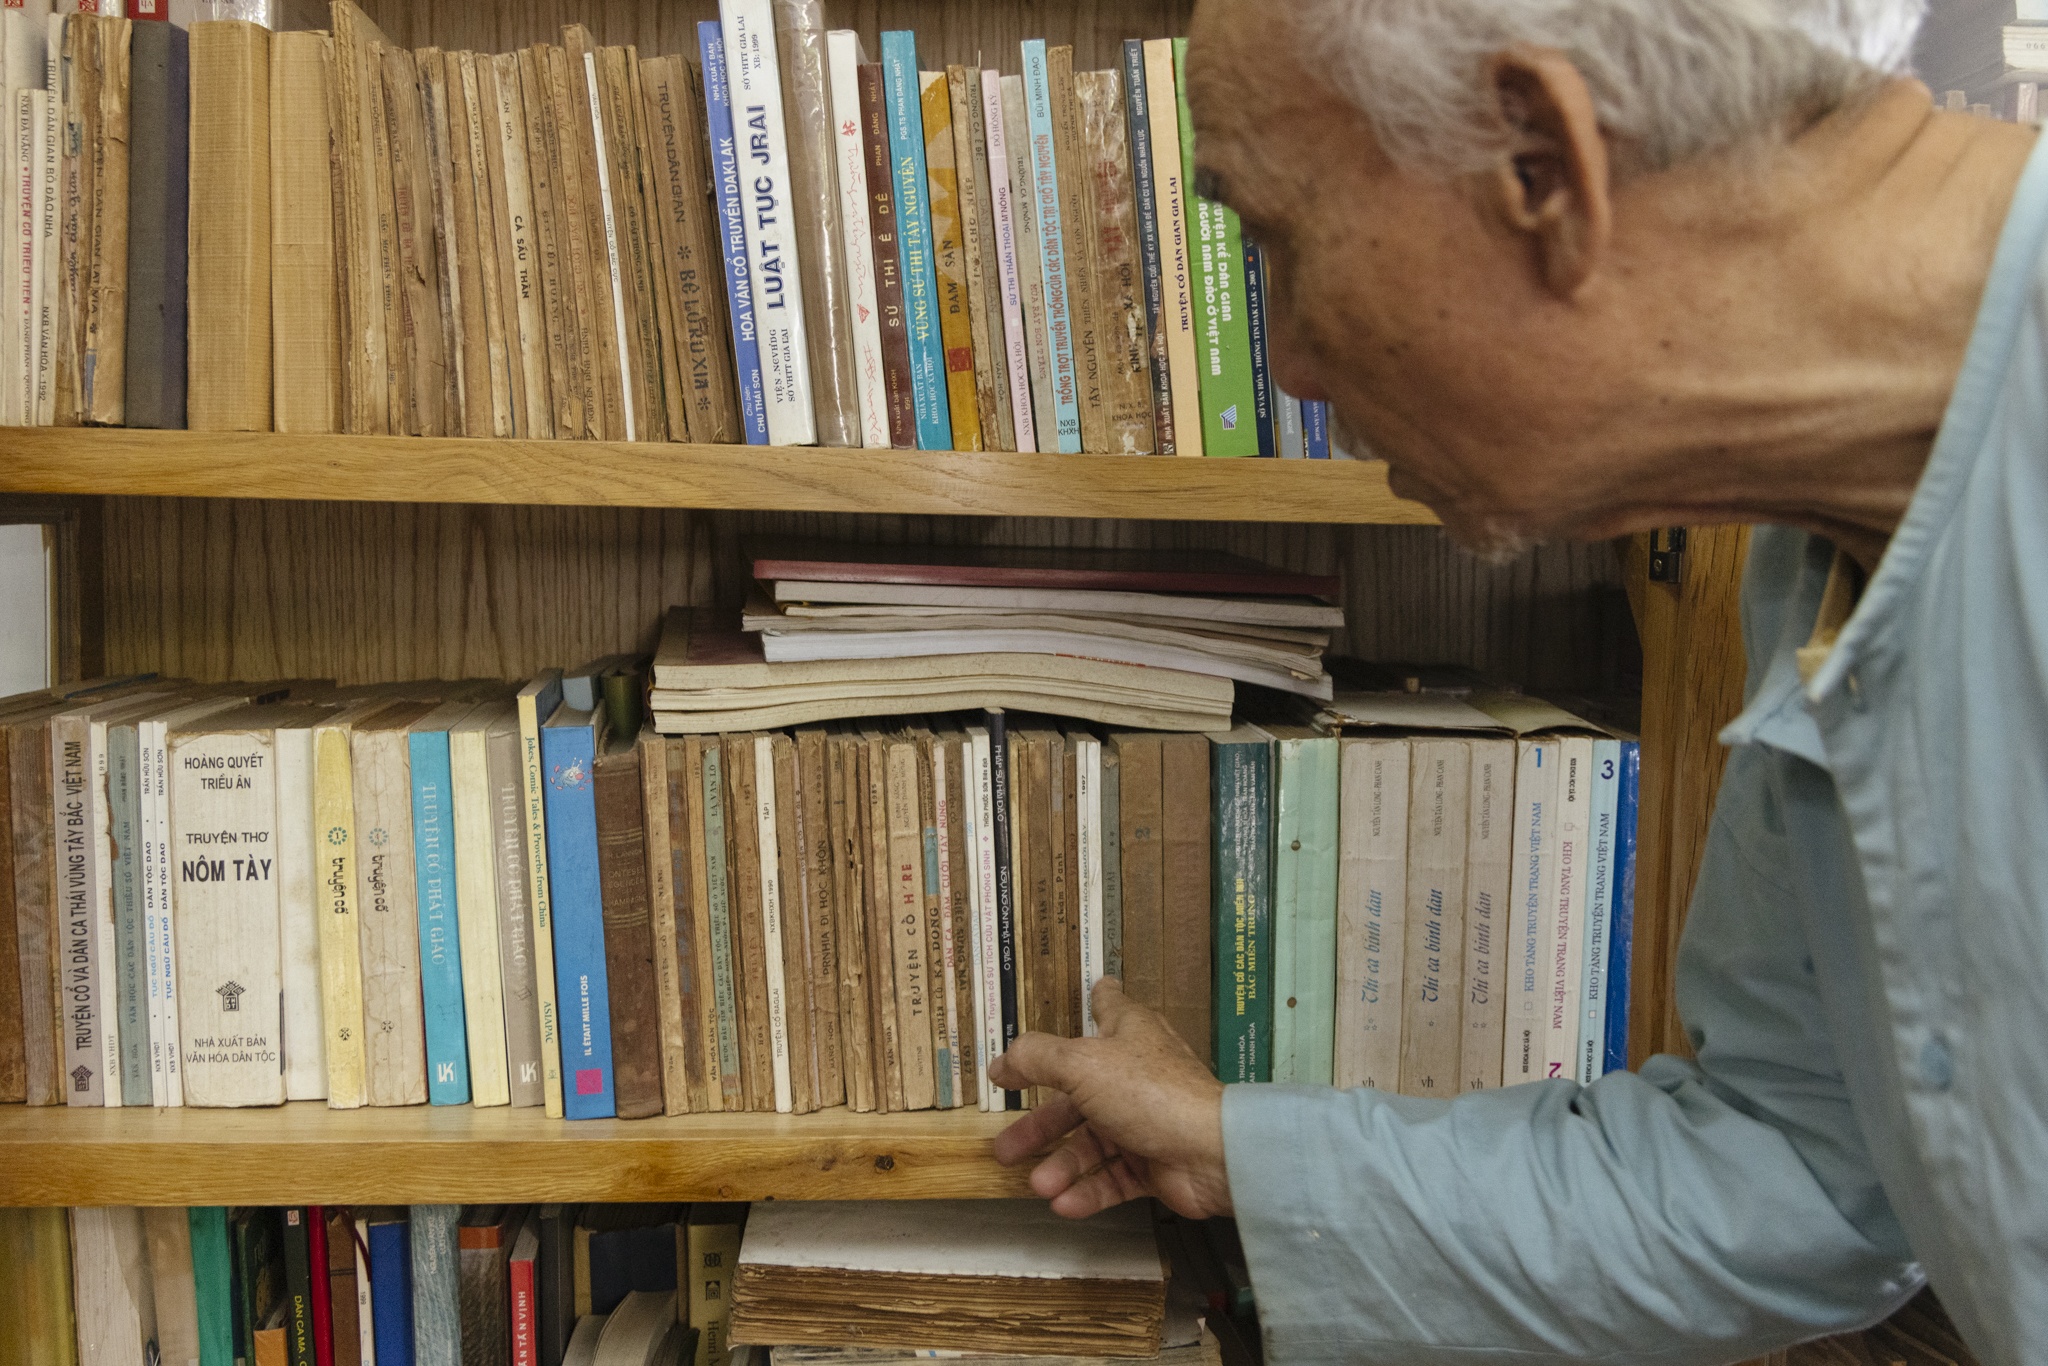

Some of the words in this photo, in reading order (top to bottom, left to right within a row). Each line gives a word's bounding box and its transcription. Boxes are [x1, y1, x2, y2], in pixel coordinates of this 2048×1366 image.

[737, 16, 746, 31] LAI
[706, 43, 716, 60] BẢN
[739, 33, 747, 49] GIA
[751, 34, 759, 52] 1999
[708, 62, 718, 82] XUẤT
[740, 52, 750, 77] VHTT
[753, 55, 761, 69] XB:
[1031, 57, 1042, 76] ĐẠO
[711, 84, 720, 101] NHÀ
[742, 78, 751, 90] SỞ
[869, 81, 878, 102] NHẬT
[1034, 78, 1044, 101] MINH
[47, 108, 57, 132] DÂN
[657, 81, 675, 146] TRUYỆN
[1036, 103, 1045, 118] BÙI
[746, 104, 771, 165] JRAI
[872, 113, 880, 134] ĐĂNG
[47, 135, 55, 163] GIAN
[874, 144, 882, 166] PHAN
[666, 149, 679, 182] DÂN
[719, 137, 738, 194] DAKLAK
[897, 156, 918, 215] NGUYÊN
[1169, 177, 1177, 195] LAI
[671, 184, 685, 223] GIAN
[753, 175, 779, 229] TỤC
[998, 187, 1009, 222] M'NÔNG
[1170, 198, 1179, 217] GIA
[44, 215, 53, 238] NHA
[722, 197, 744, 253] TRUYỀN
[903, 219, 921, 246] TÂY
[1002, 223, 1012, 250] THOẠI
[1172, 219, 1182, 245] GIAN
[878, 233, 891, 242] Ê
[726, 256, 747, 277] CỔ
[909, 249, 922, 274] THI
[1175, 249, 1184, 271] DÂN
[758, 240, 786, 310] LUẬT
[883, 259, 896, 287] THI
[1174, 273, 1186, 288] CỔ
[735, 280, 751, 308] VĂN
[907, 275, 926, 297] SỬ
[1008, 293, 1017, 306] SỬ
[1179, 291, 1189, 332] TRUYỆN
[740, 311, 755, 341] HOA
[884, 306, 900, 327] SỬ
[911, 299, 930, 341] VÙNG
[751, 369, 761, 388] SƠN
[753, 391, 764, 411] THÁI
[756, 412, 766, 433] CHU
[64, 741, 81, 767] NAM
[184, 753, 225, 770] HOÀNG
[227, 751, 264, 770] QUYẾT
[525, 736, 536, 763] Jokes,
[1535, 748, 1542, 768] 1
[528, 764, 539, 794] Comic
[1600, 759, 1614, 780] 3
[62, 770, 86, 796] VIỆT
[201, 773, 234, 791] TRIỀU
[236, 774, 252, 790] ÂN
[59, 801, 83, 826] BẮC
[531, 796, 540, 821] Tales
[1532, 802, 1542, 827] NAM
[533, 823, 540, 831] &
[1135, 827, 1151, 839] 2
[1600, 813, 1610, 837] NAM
[63, 829, 84, 852] TÂY
[186, 830, 239, 847] TRUYỆN
[243, 831, 270, 844] THƠ
[1527, 828, 1541, 853] VIỆT
[1596, 838, 1609, 863] VIỆT
[532, 833, 543, 874] Proverbs
[982, 850, 991, 870] SINH
[1562, 841, 1573, 865] KHO
[64, 855, 85, 888] VÙNG
[182, 855, 225, 883] NÔM
[233, 854, 272, 882] TÀY
[999, 866, 1008, 887] NGỤ
[1529, 855, 1540, 891] TRẠNG
[535, 876, 545, 898] from
[981, 872, 992, 904] PHÓNG
[1561, 867, 1574, 895] TÀNG
[1595, 865, 1608, 901] TRẠNG
[65, 890, 87, 917] THÁI
[1001, 888, 1010, 919] NGÔN
[1425, 888, 1443, 916] dân
[1523, 893, 1539, 935] TRUYỆN
[538, 901, 547, 928] China
[901, 914, 916, 936] CỔ
[982, 906, 994, 923] VẬT
[1247, 894, 1256, 940] TRUNG
[1558, 897, 1570, 940] TRUYỆN
[1592, 903, 1604, 945] TRUYỆN
[70, 919, 88, 936] CA
[983, 927, 992, 943] CỨU
[1001, 920, 1011, 944] PHẬT
[69, 938, 88, 963] DÂN
[984, 944, 993, 965] TÍCH
[1003, 946, 1012, 971] GIÁO
[1243, 945, 1256, 972] MIỀN
[1523, 938, 1536, 966] TÀNG
[1556, 941, 1567, 977] TRẠNG
[1586, 947, 1601, 975] TÀNG
[68, 966, 89, 982] VÀ
[986, 966, 996, 978] SỰ
[1428, 958, 1441, 972] ca
[66, 981, 90, 1002] CỔ
[580, 975, 589, 996] FOIS
[907, 949, 922, 1016] TRUYỆN
[986, 979, 994, 990] cổ
[1244, 978, 1256, 999] BẮC
[1421, 978, 1439, 1003] Thi
[1524, 968, 1534, 992] KHO
[1554, 979, 1567, 1003] VIỆT
[1589, 977, 1599, 1000] KHO
[581, 998, 591, 1023] MILLE
[772, 988, 781, 1014] RAGLAI
[987, 992, 996, 1020] Truyện
[71, 1005, 95, 1050] TRUYỆN
[543, 1001, 553, 1044] ASIAPAC
[772, 1016, 782, 1027] CỔ
[1553, 1006, 1563, 1029] NAM
[194, 1033, 216, 1049] NHÀ
[217, 1032, 245, 1048] XUẤT
[247, 1035, 267, 1047] BẢN
[582, 1024, 592, 1046] ÉTAIT
[775, 1029, 784, 1058] TRUYỆN
[186, 1050, 207, 1064] VĂN
[208, 1050, 229, 1063] HÓA
[229, 1050, 252, 1063] DÂN
[253, 1051, 276, 1064] TỘC
[584, 1047, 592, 1056] IL
[294, 1295, 304, 1317] DÂN
[296, 1320, 305, 1335] CA
[707, 1320, 720, 1354] Henri
